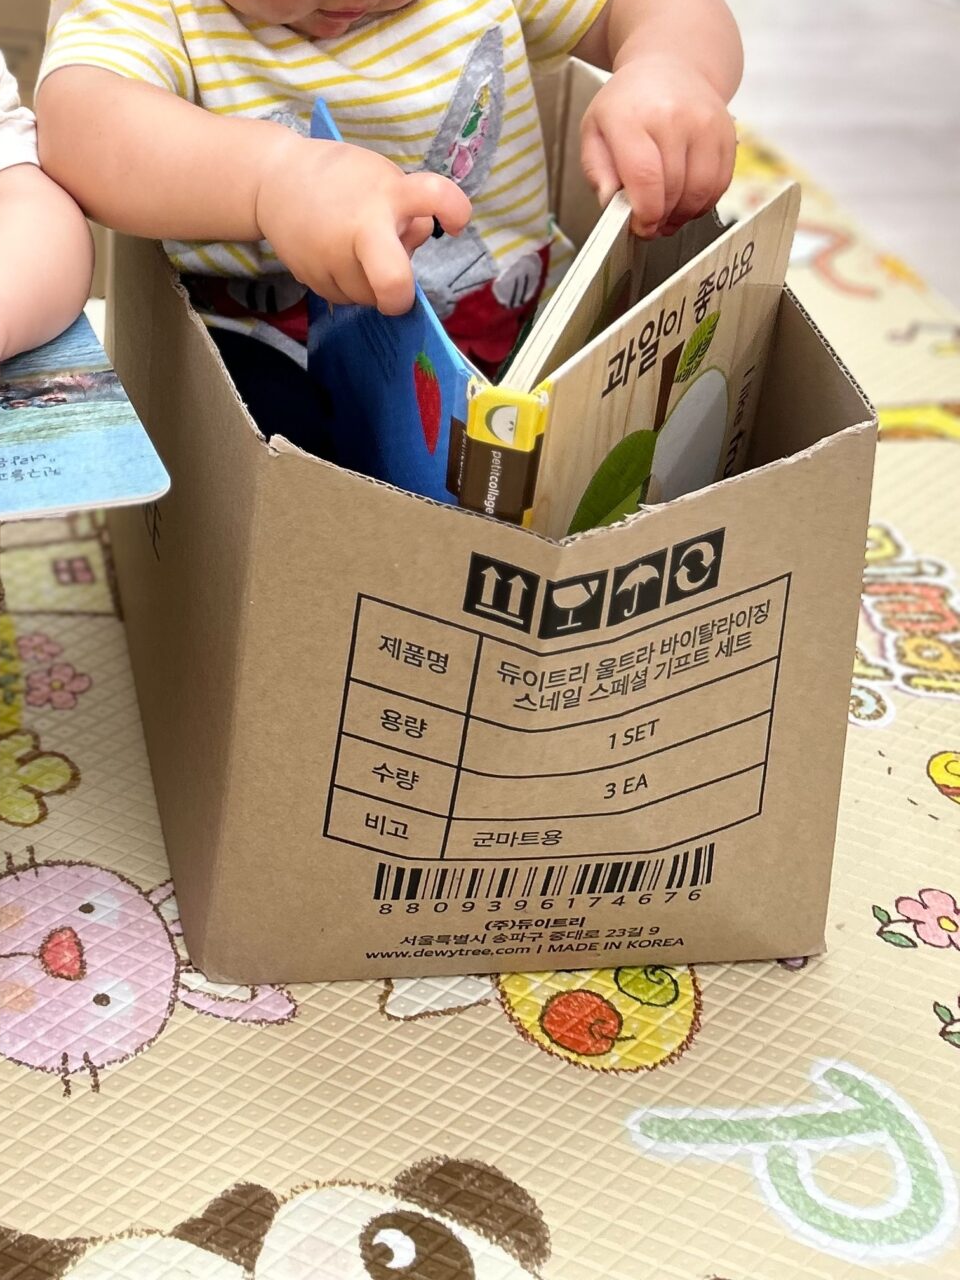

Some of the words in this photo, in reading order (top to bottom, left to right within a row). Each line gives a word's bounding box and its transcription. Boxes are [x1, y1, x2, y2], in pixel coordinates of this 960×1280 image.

[601, 296, 687, 399] 과일이
[693, 241, 756, 324] 좋아요
[485, 450, 502, 516] petitcollage
[378, 635, 449, 674] 제품명
[497, 661, 589, 693] 듀이트리
[594, 644, 655, 680] 울트라
[659, 599, 771, 655] 바이탈라이징
[513, 686, 582, 712] 스네일
[587, 668, 649, 703] 스페셜
[654, 650, 710, 682] 기프트
[713, 628, 752, 658] 세트
[380, 709, 428, 738] 용량
[609, 733, 616, 749] 1
[622, 718, 660, 746] SET
[371, 763, 419, 790] 수량
[604, 783, 616, 799] 3
[623, 773, 648, 794] EA
[365, 813, 409, 840] 비고
[473, 830, 563, 847] 군마트용
[400, 934, 487, 946] 서울특별시
[490, 928, 543, 945] 송파구
[547, 926, 600, 943] 중대로
[605, 927, 643, 938] 23길
[649, 927, 660, 935] 9
[485, 917, 588, 932] (주)듀이트리
[366, 943, 531, 959] www.dewytree.com
[547, 940, 599, 952] MADE
[603, 941, 622, 950] IN
[627, 935, 684, 949] KOREA
